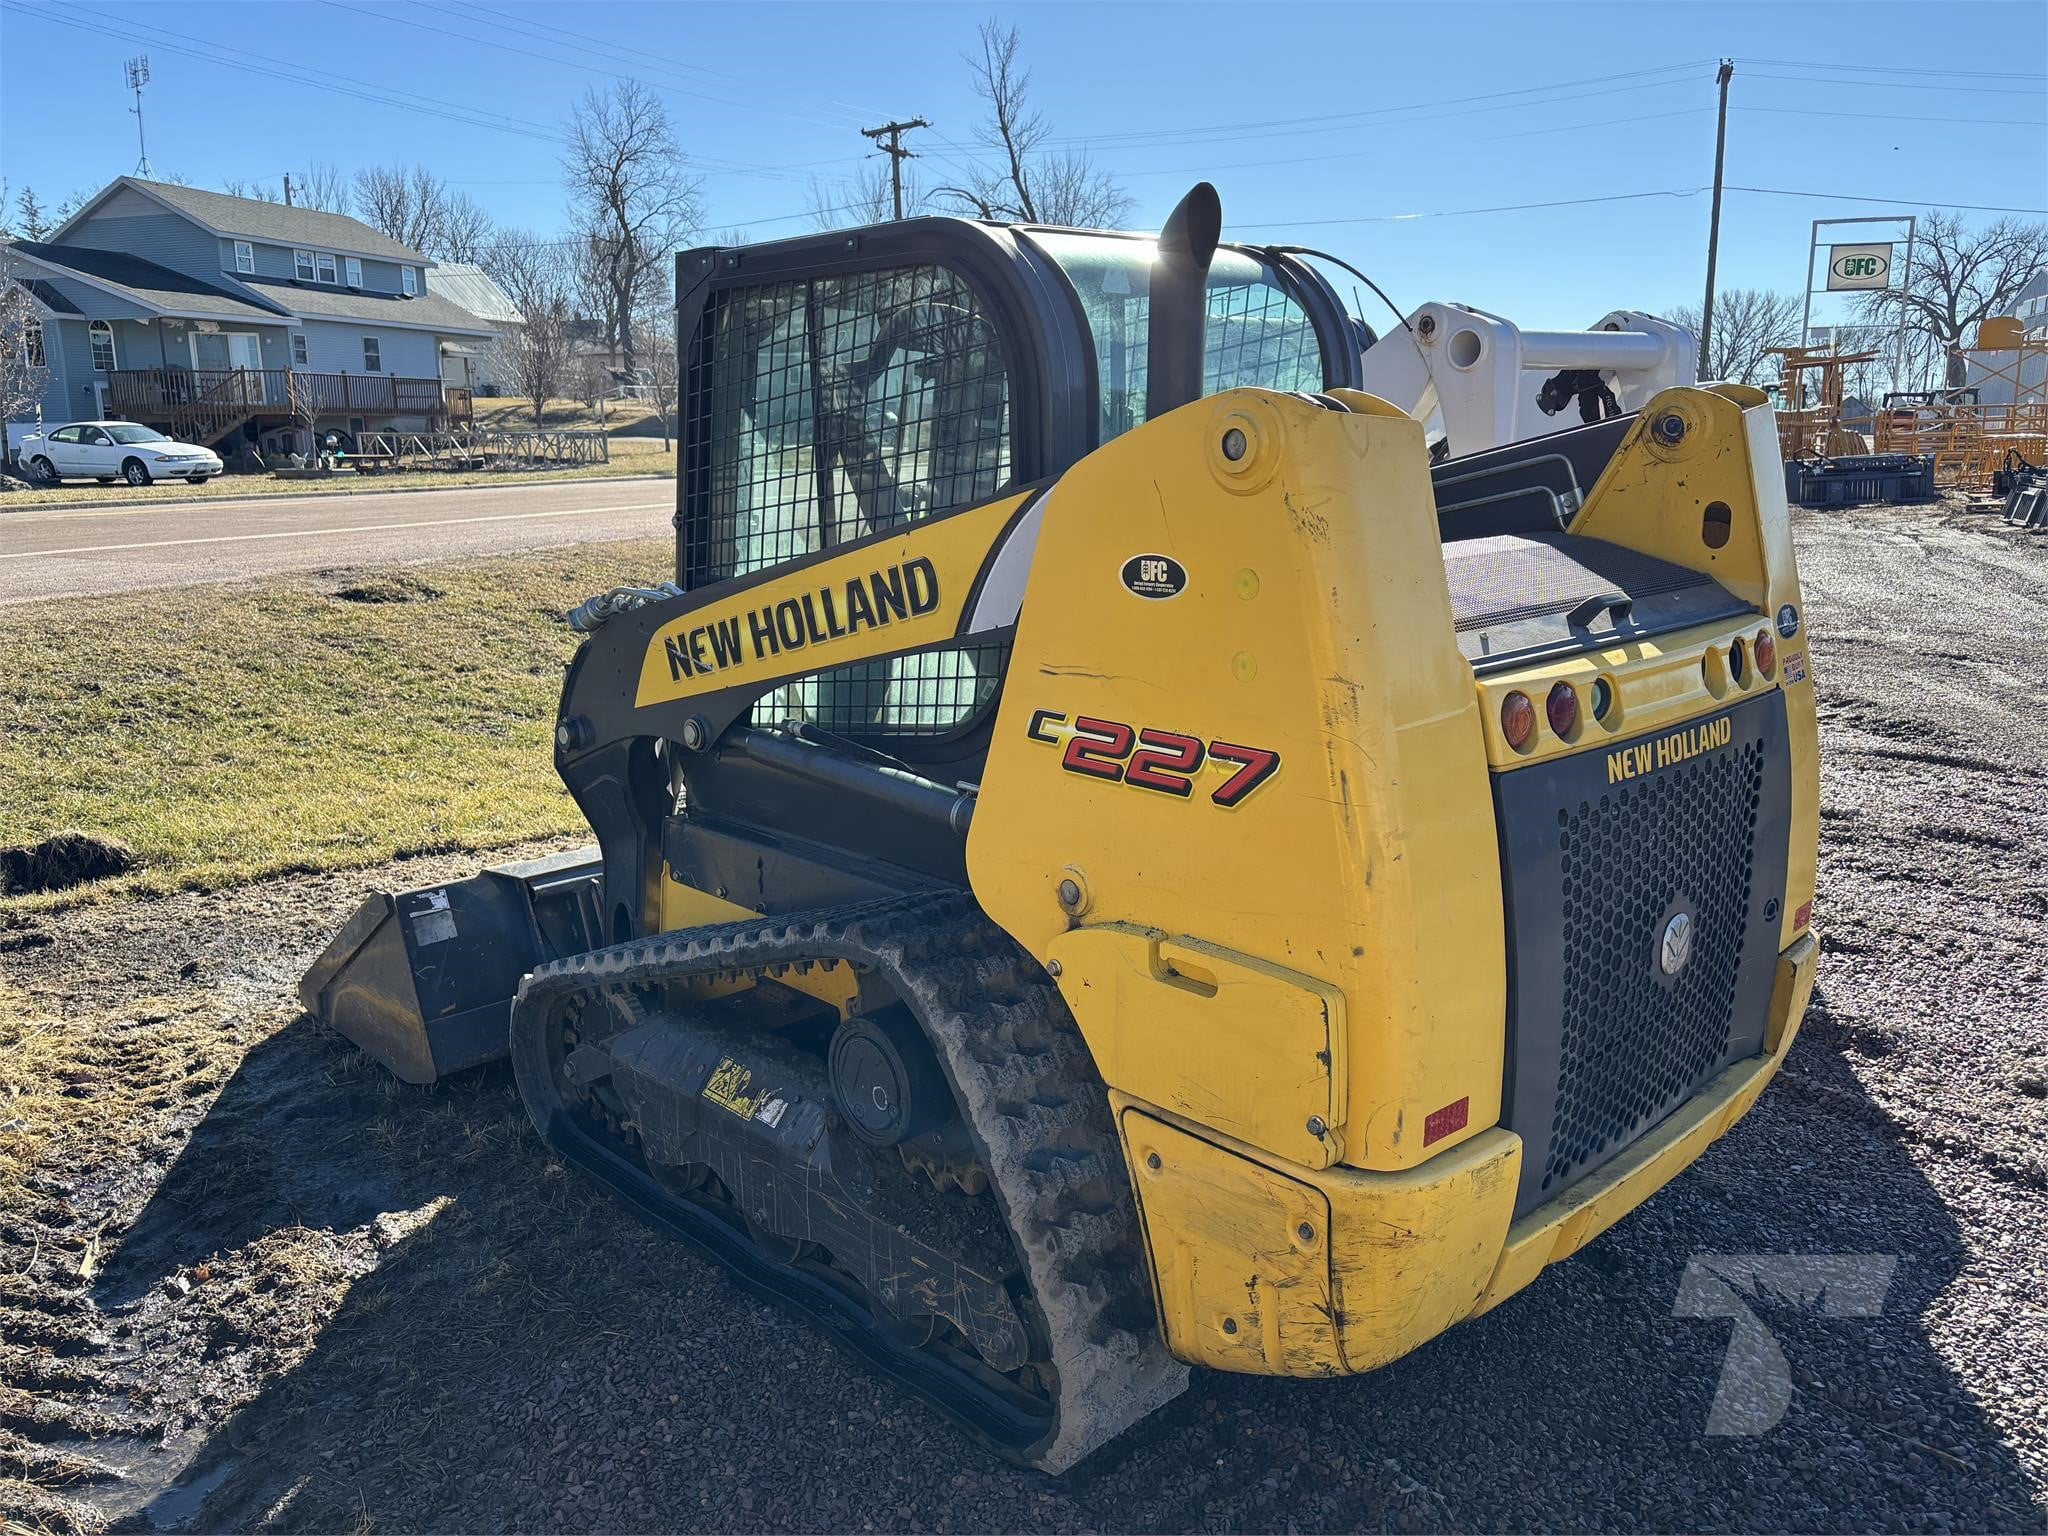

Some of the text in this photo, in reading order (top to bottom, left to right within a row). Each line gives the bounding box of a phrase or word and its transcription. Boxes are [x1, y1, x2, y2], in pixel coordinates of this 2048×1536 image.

[1844, 257, 1876, 276] UFC
[1141, 560, 1167, 582] UFC
[664, 555, 941, 683] NEW HOLLAND
[1607, 716, 1732, 784] NEW HOLLAND
